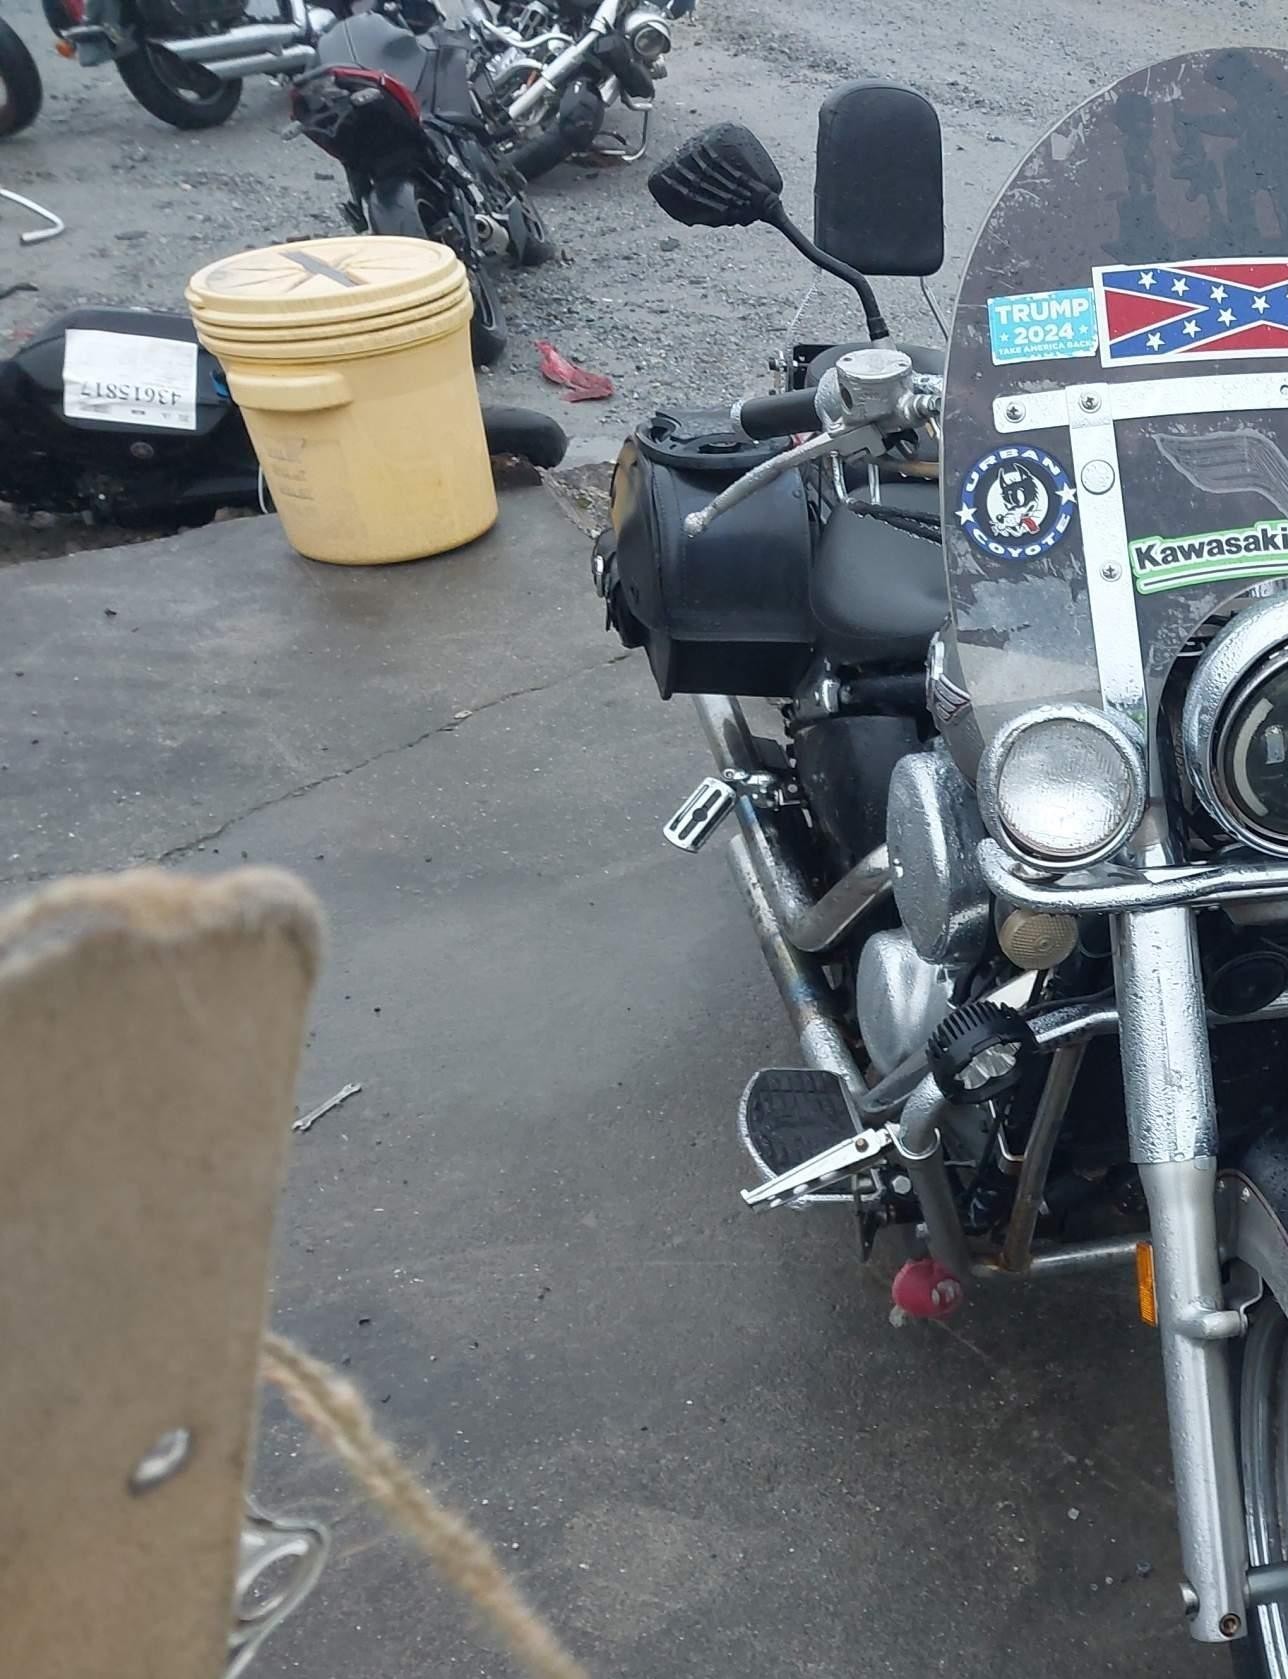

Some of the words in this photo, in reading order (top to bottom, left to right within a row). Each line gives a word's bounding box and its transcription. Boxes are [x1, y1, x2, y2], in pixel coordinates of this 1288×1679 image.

[994, 298, 1090, 325] TRUMP
[1013, 322, 1075, 345] 2024
[999, 347, 1022, 355] TAKE
[1024, 341, 1065, 353] AMERICA
[966, 449, 1061, 492] URBAN
[972, 513, 1071, 558] COYOTE
